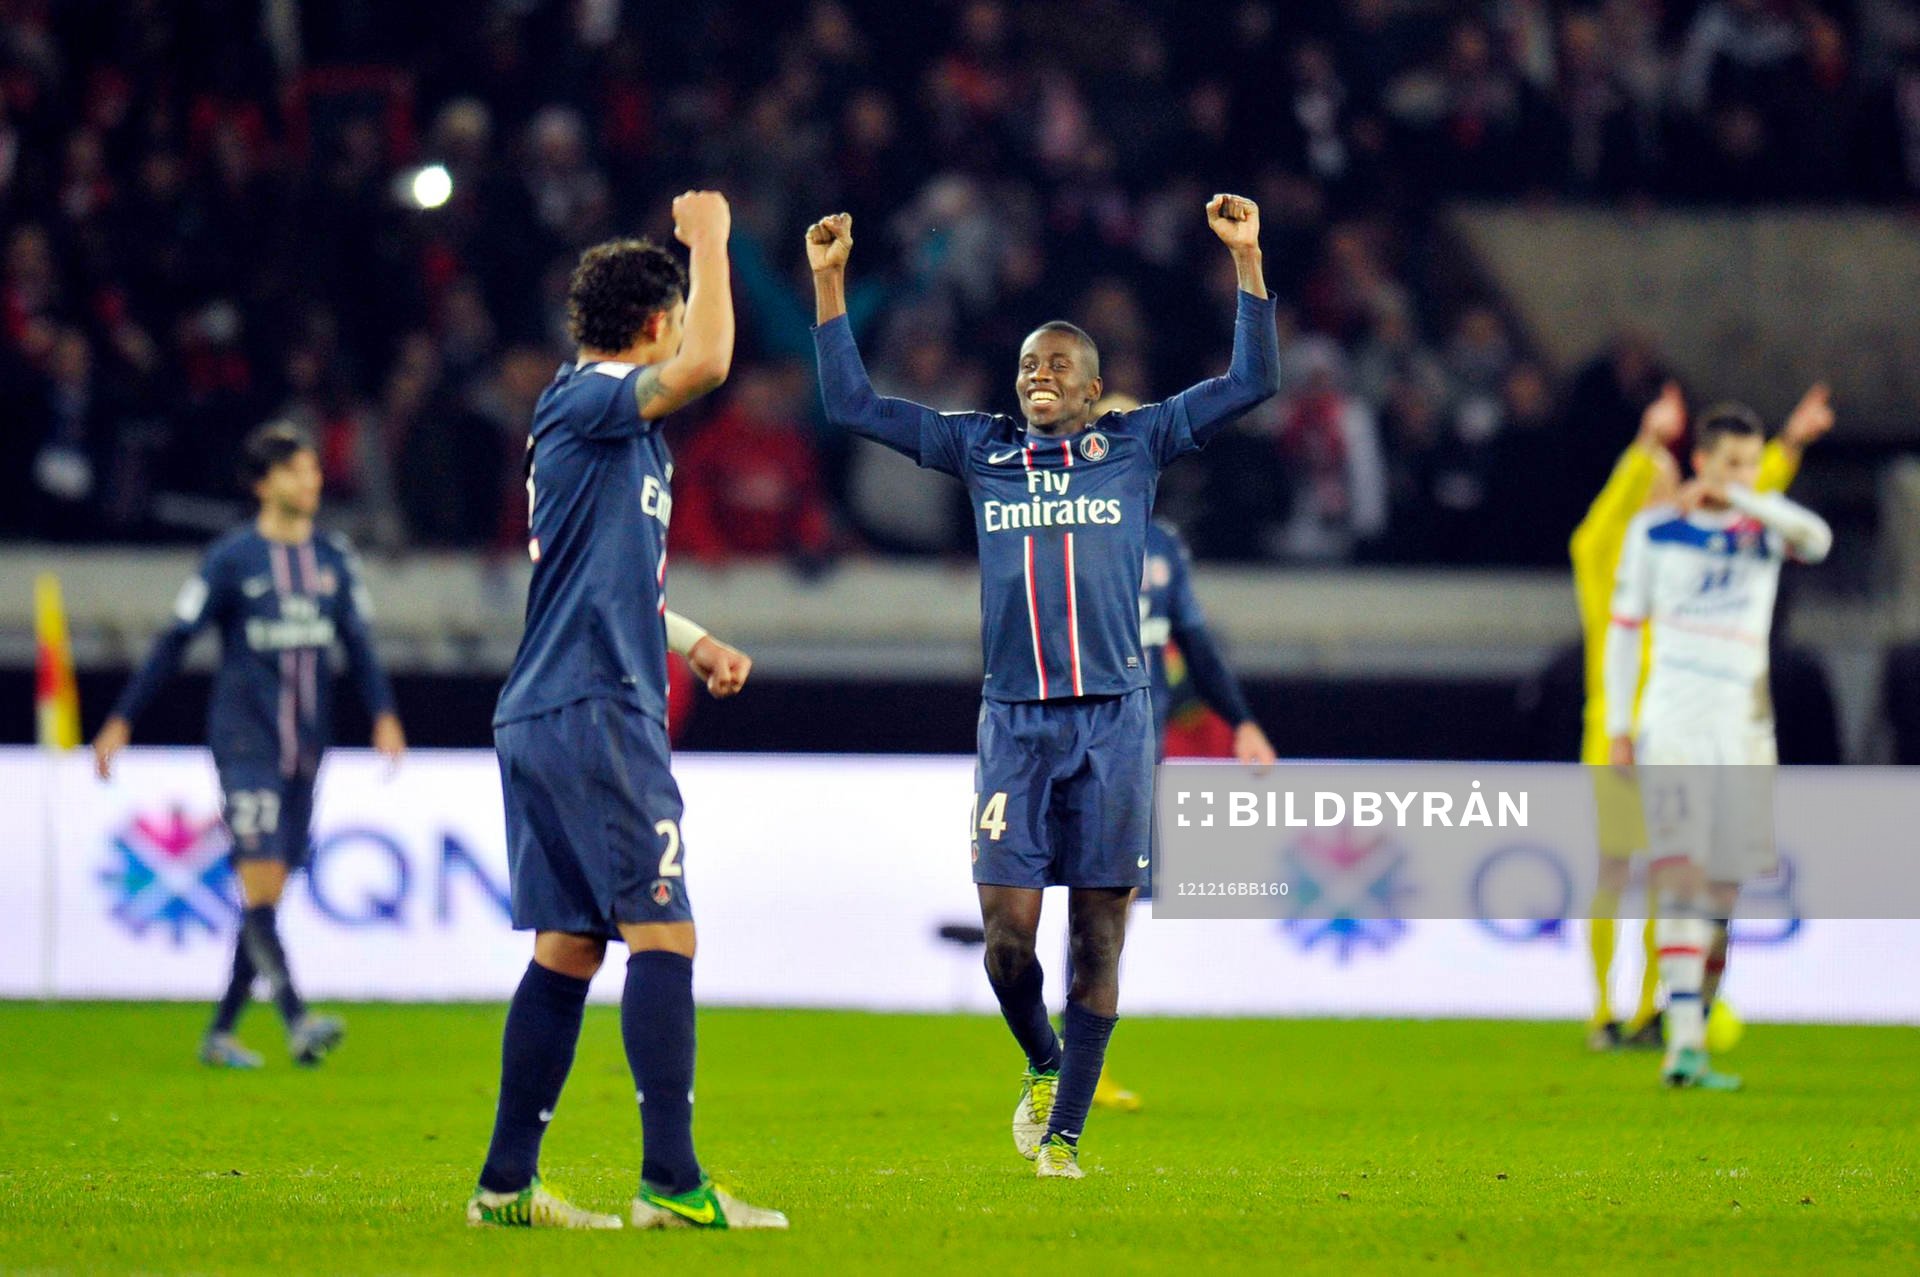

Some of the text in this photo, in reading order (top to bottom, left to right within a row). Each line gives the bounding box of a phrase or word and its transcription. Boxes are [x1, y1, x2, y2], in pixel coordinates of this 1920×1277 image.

[1027, 470, 1070, 495] Fly
[984, 495, 1122, 532] Emirates
[655, 819, 682, 877] 2
